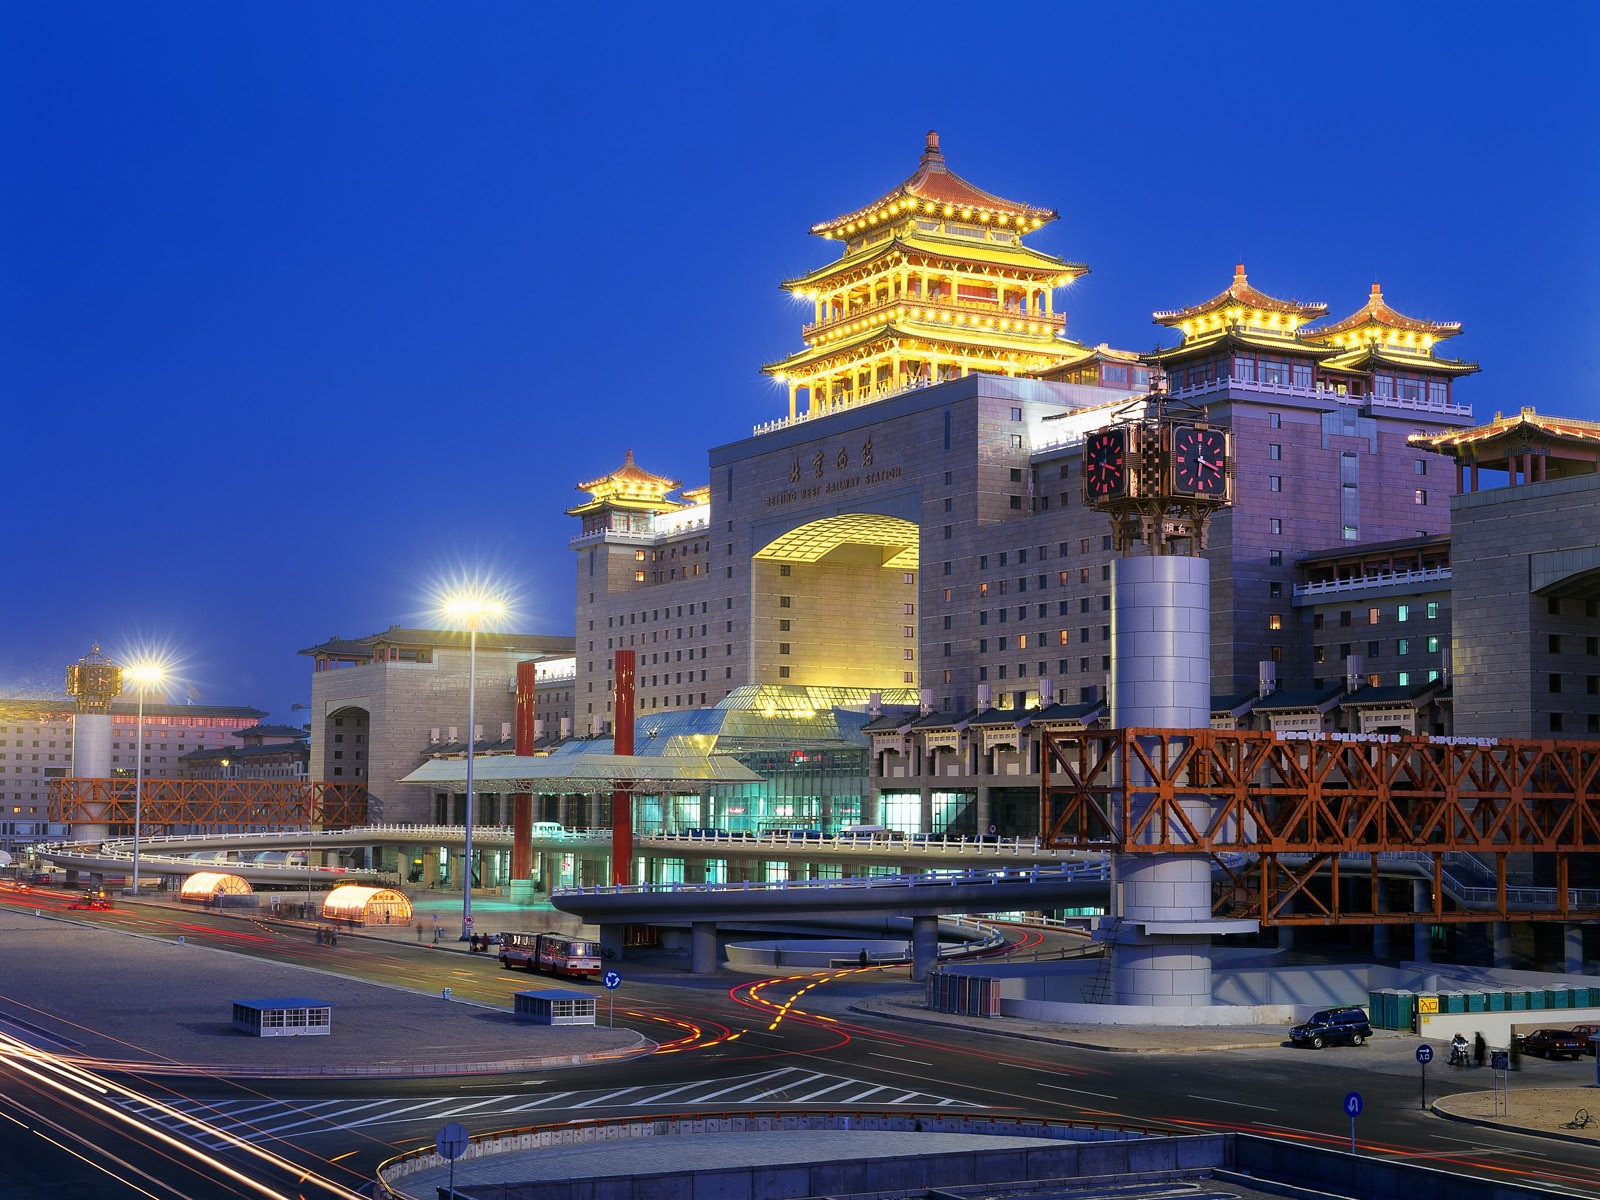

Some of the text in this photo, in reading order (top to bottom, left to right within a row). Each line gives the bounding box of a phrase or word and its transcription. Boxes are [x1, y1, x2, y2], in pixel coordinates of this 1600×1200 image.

[790, 436, 873, 483] 北京西站
[766, 466, 902, 508] BEIJING WEST RAILWAY STATION
[1420, 1000, 1437, 1011] 入口
